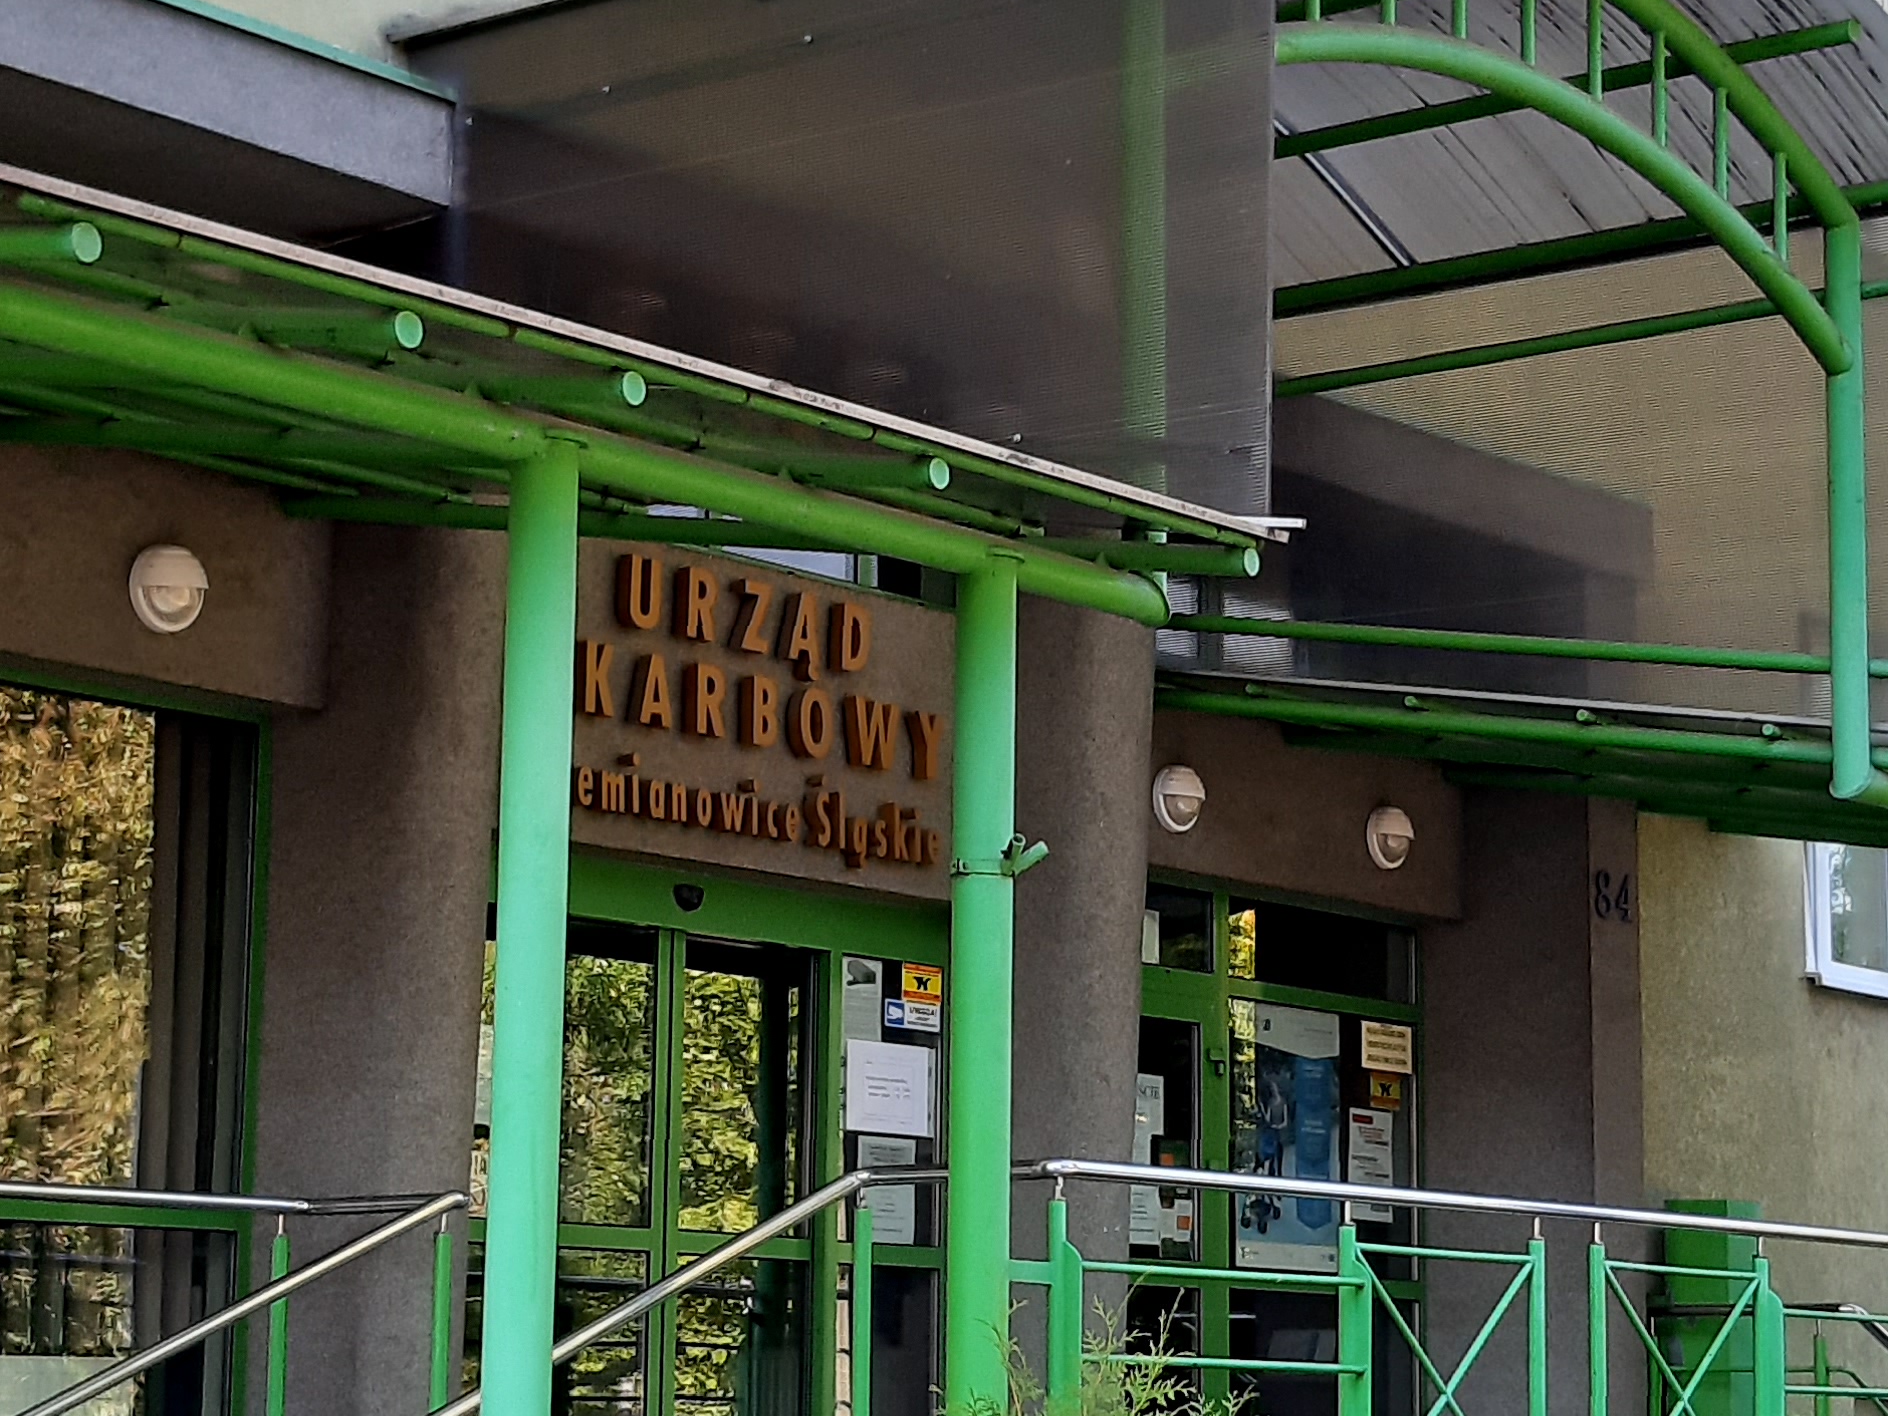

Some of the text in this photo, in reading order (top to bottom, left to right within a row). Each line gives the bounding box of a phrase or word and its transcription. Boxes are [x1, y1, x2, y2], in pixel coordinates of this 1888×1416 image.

[616, 552, 872, 682] URZĄD
[577, 639, 944, 781] KARBOWY
[575, 752, 801, 843] emianowice
[1594, 869, 1633, 923] 84
